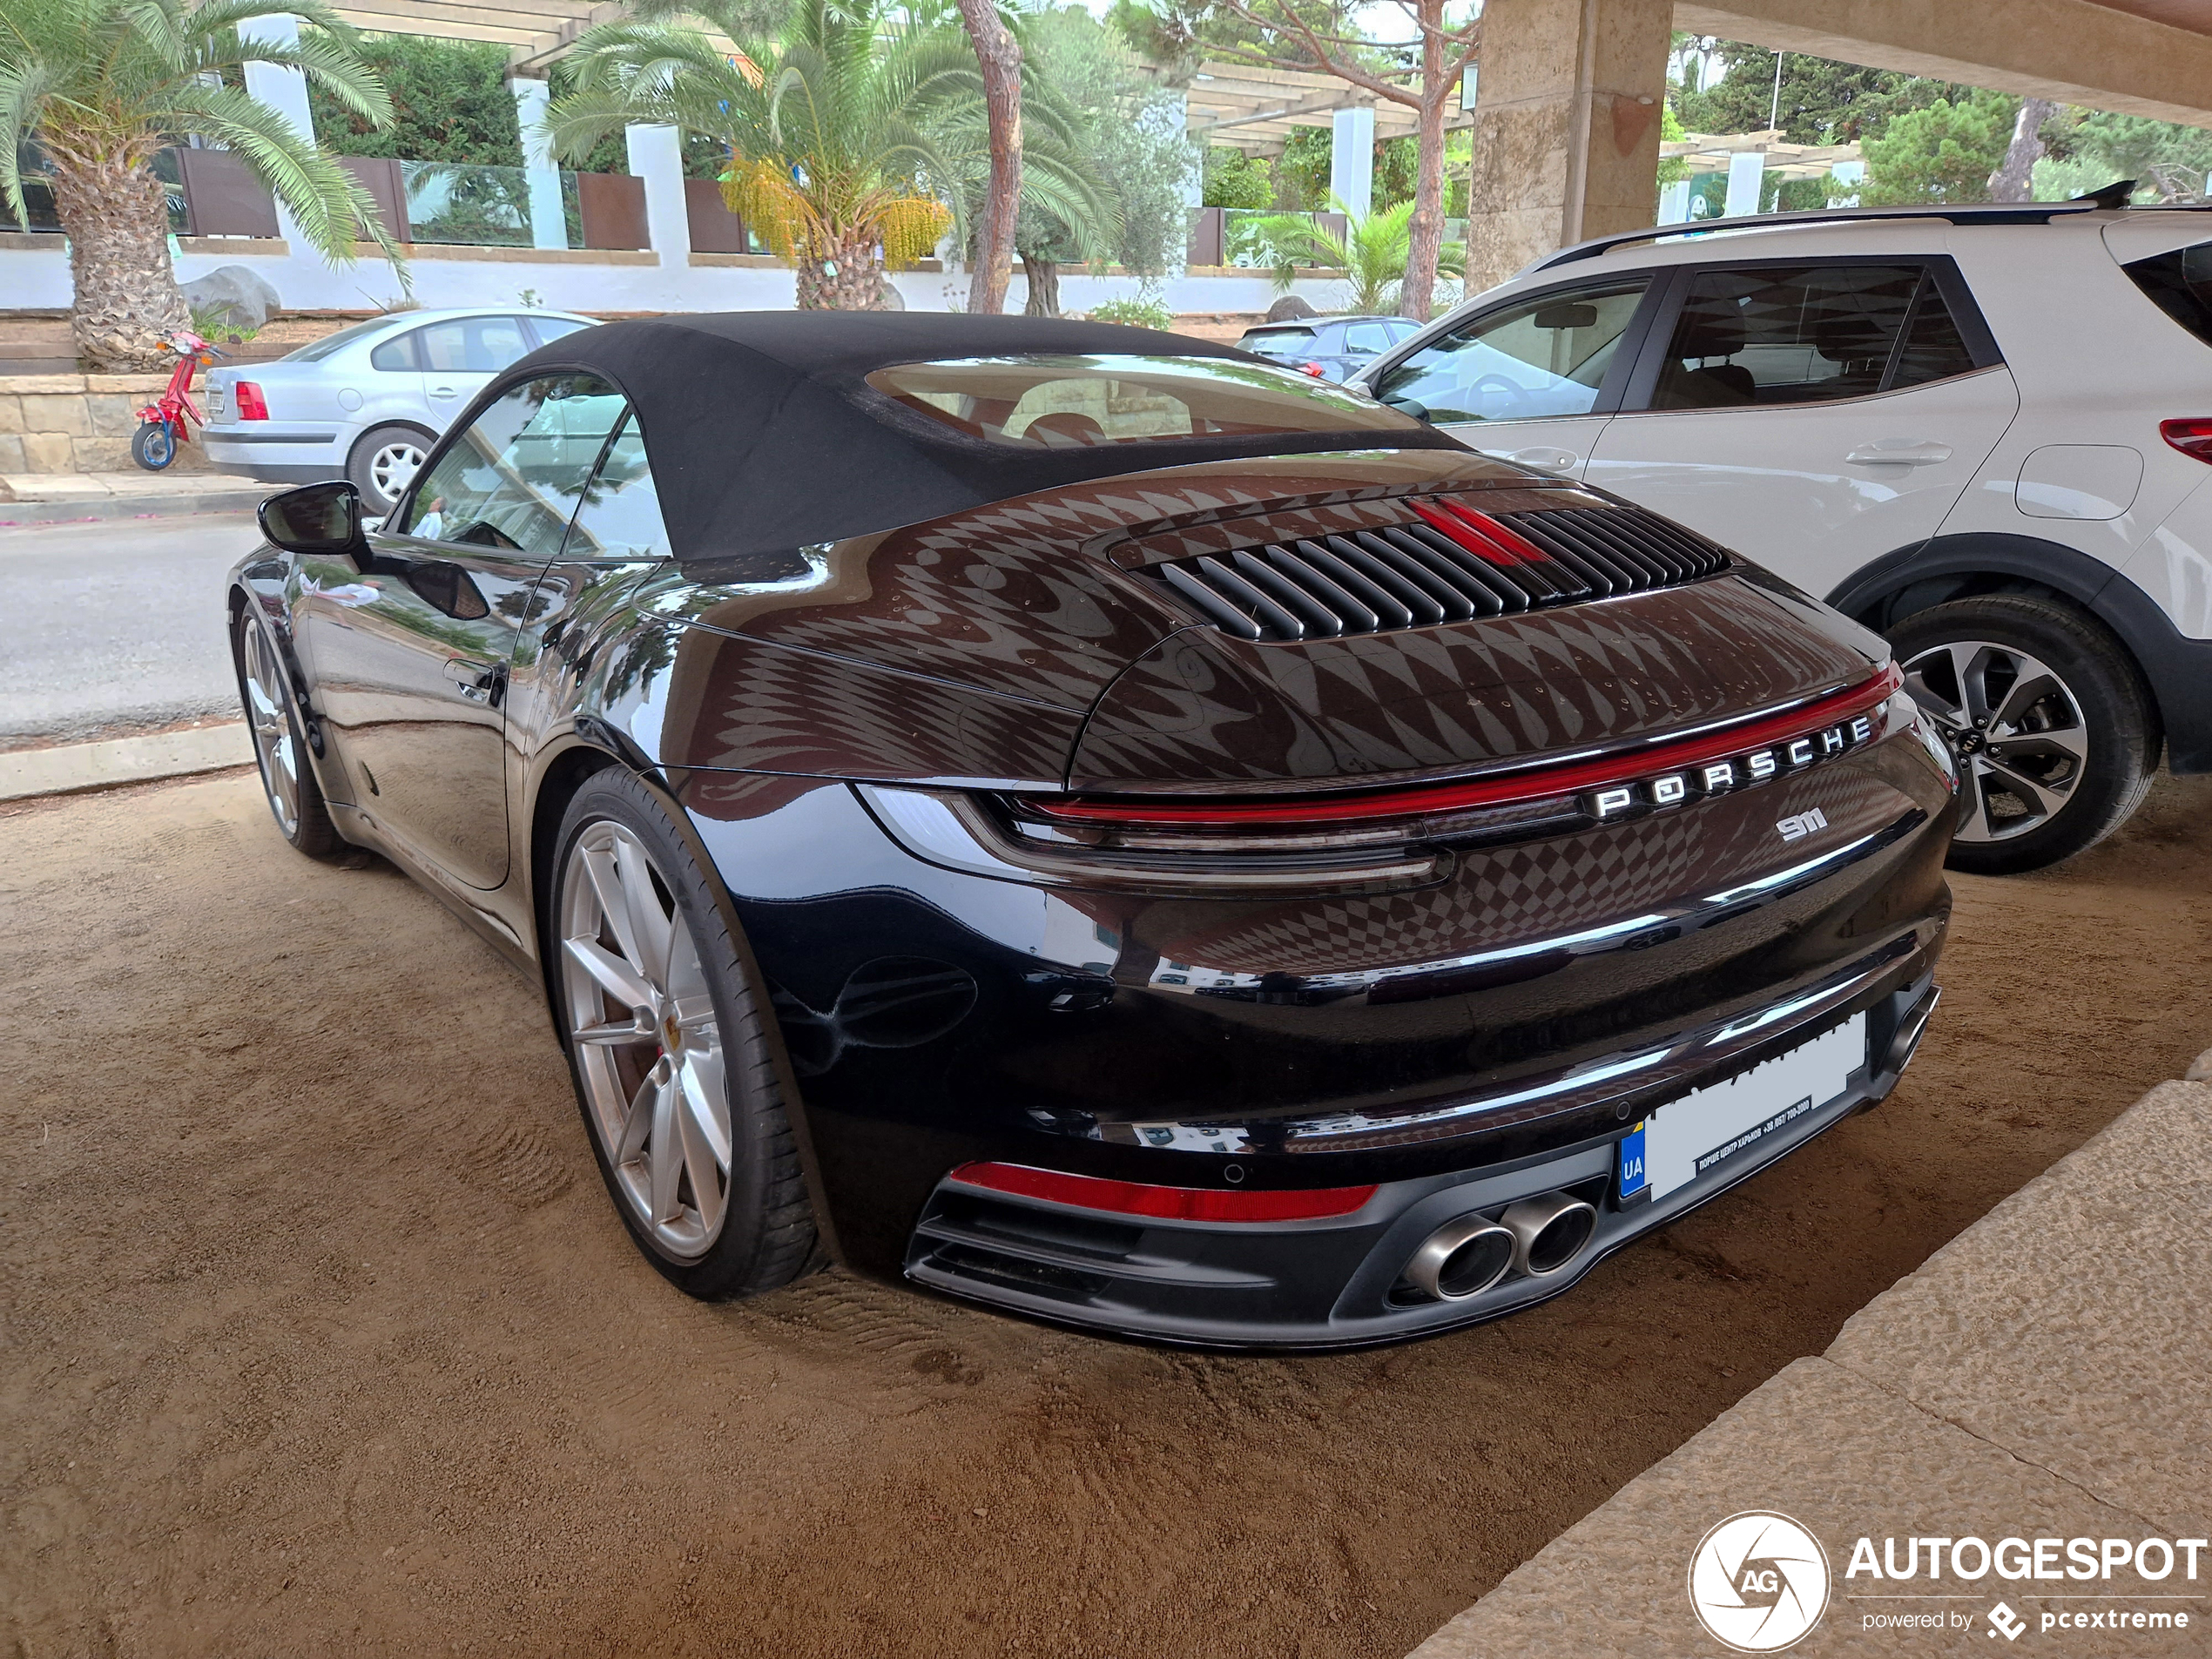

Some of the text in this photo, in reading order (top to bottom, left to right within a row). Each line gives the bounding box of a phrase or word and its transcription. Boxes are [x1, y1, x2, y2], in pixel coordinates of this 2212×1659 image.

[1962, 734, 1979, 752] KIA
[1596, 716, 1871, 817] PORSCHE
[1776, 807, 1828, 841] 911
[1699, 1151, 1720, 1170] ПОРШЕ
[1720, 1141, 1738, 1159] ЦЕНТР
[1737, 1128, 1762, 1149] ХАРЬКОВ
[1763, 1120, 1774, 1134] +38
[1624, 1157, 1642, 1180] UA
